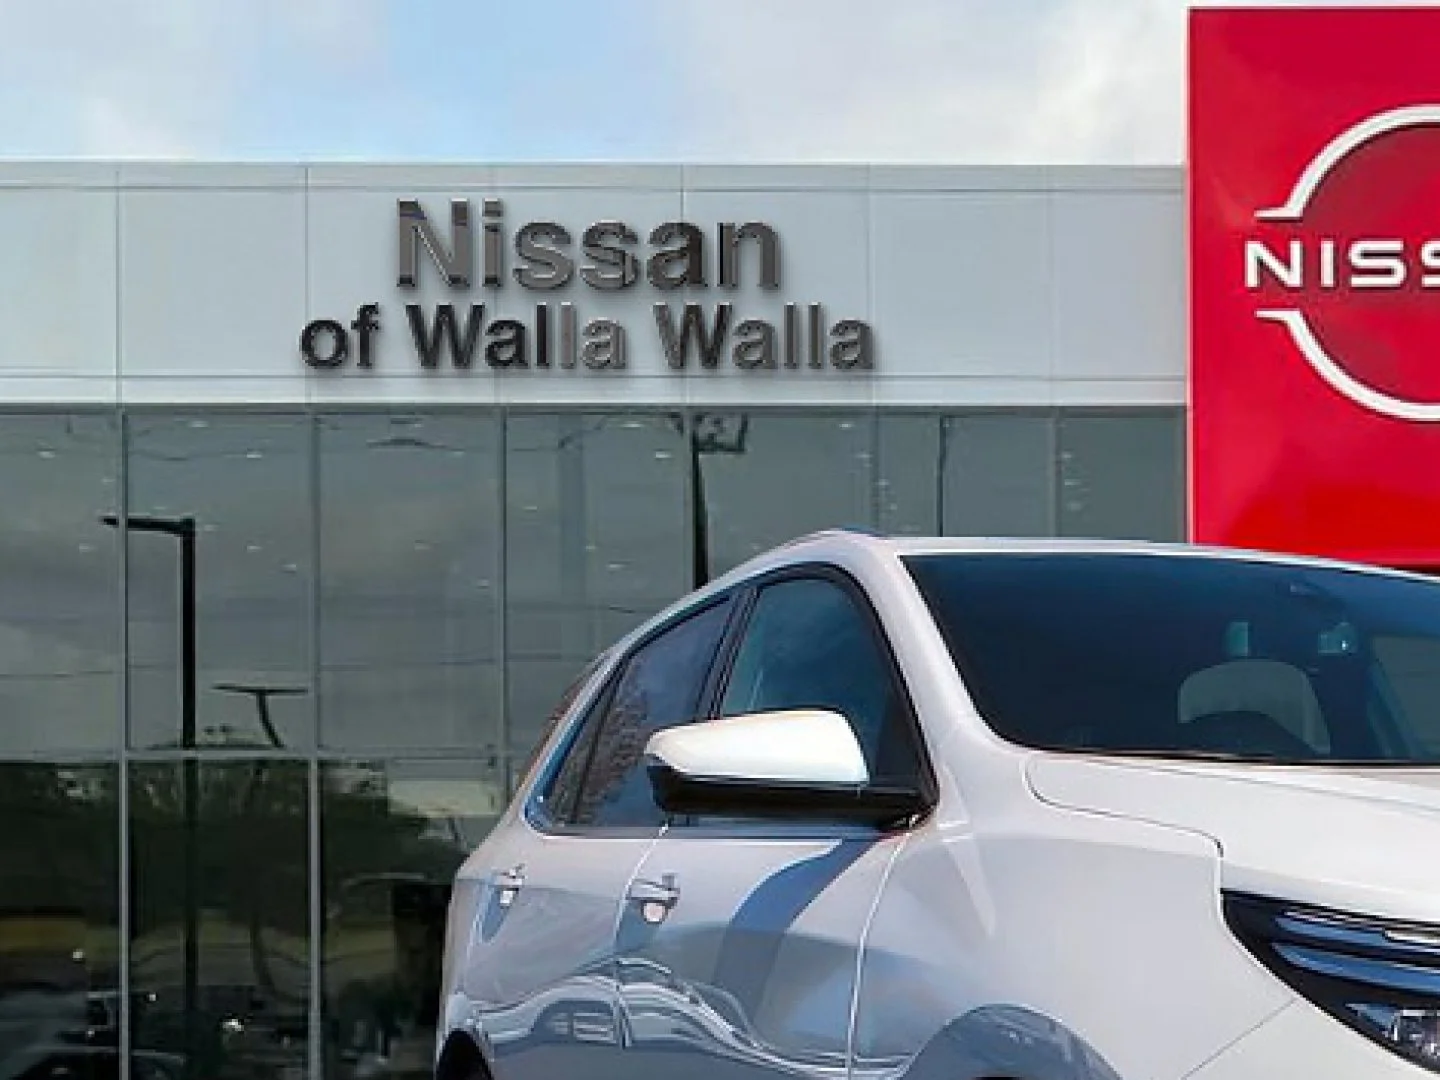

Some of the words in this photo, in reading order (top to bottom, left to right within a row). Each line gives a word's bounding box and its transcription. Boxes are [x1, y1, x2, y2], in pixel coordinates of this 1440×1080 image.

[396, 198, 781, 290] Nissan
[300, 302, 383, 370] of
[405, 302, 629, 370] Walla
[652, 302, 875, 370] Walla
